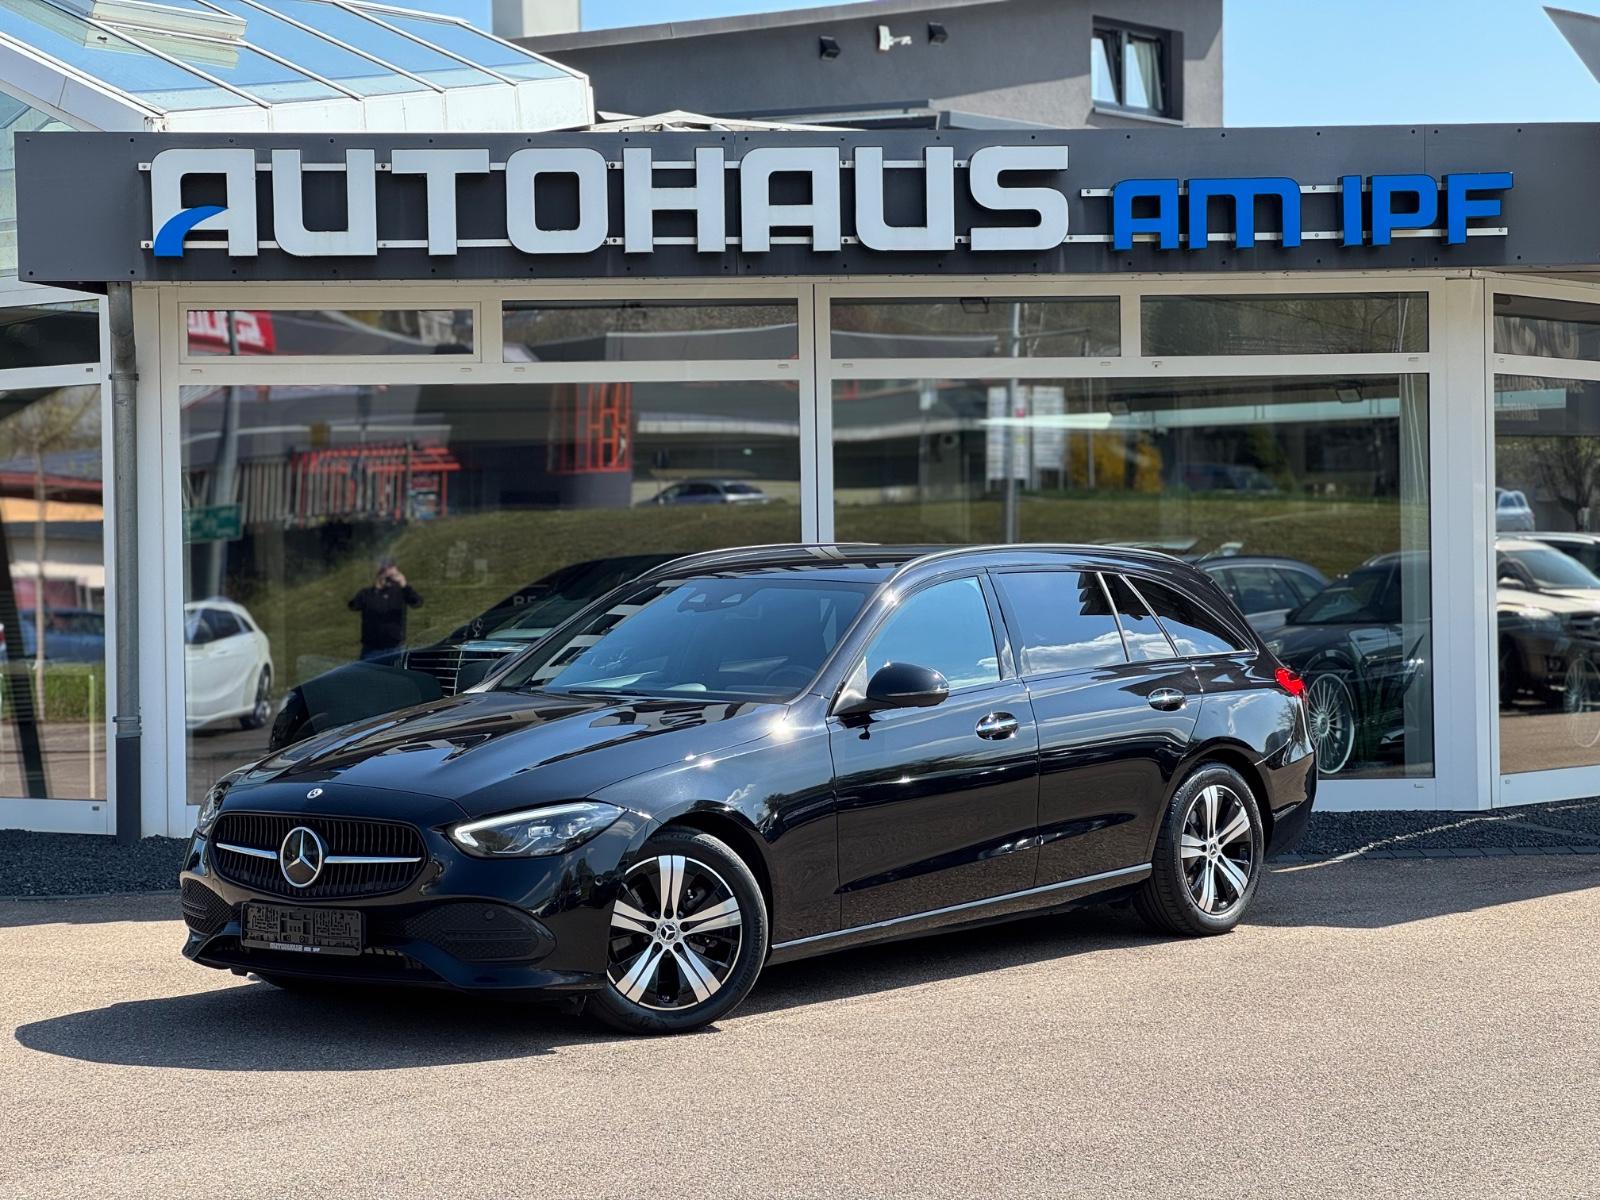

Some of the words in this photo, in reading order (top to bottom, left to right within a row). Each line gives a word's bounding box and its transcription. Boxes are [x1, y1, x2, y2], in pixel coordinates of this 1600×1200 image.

[151, 145, 1069, 257] AUTOHAUS
[1110, 176, 1301, 250] AM
[1338, 171, 1513, 248] IPF
